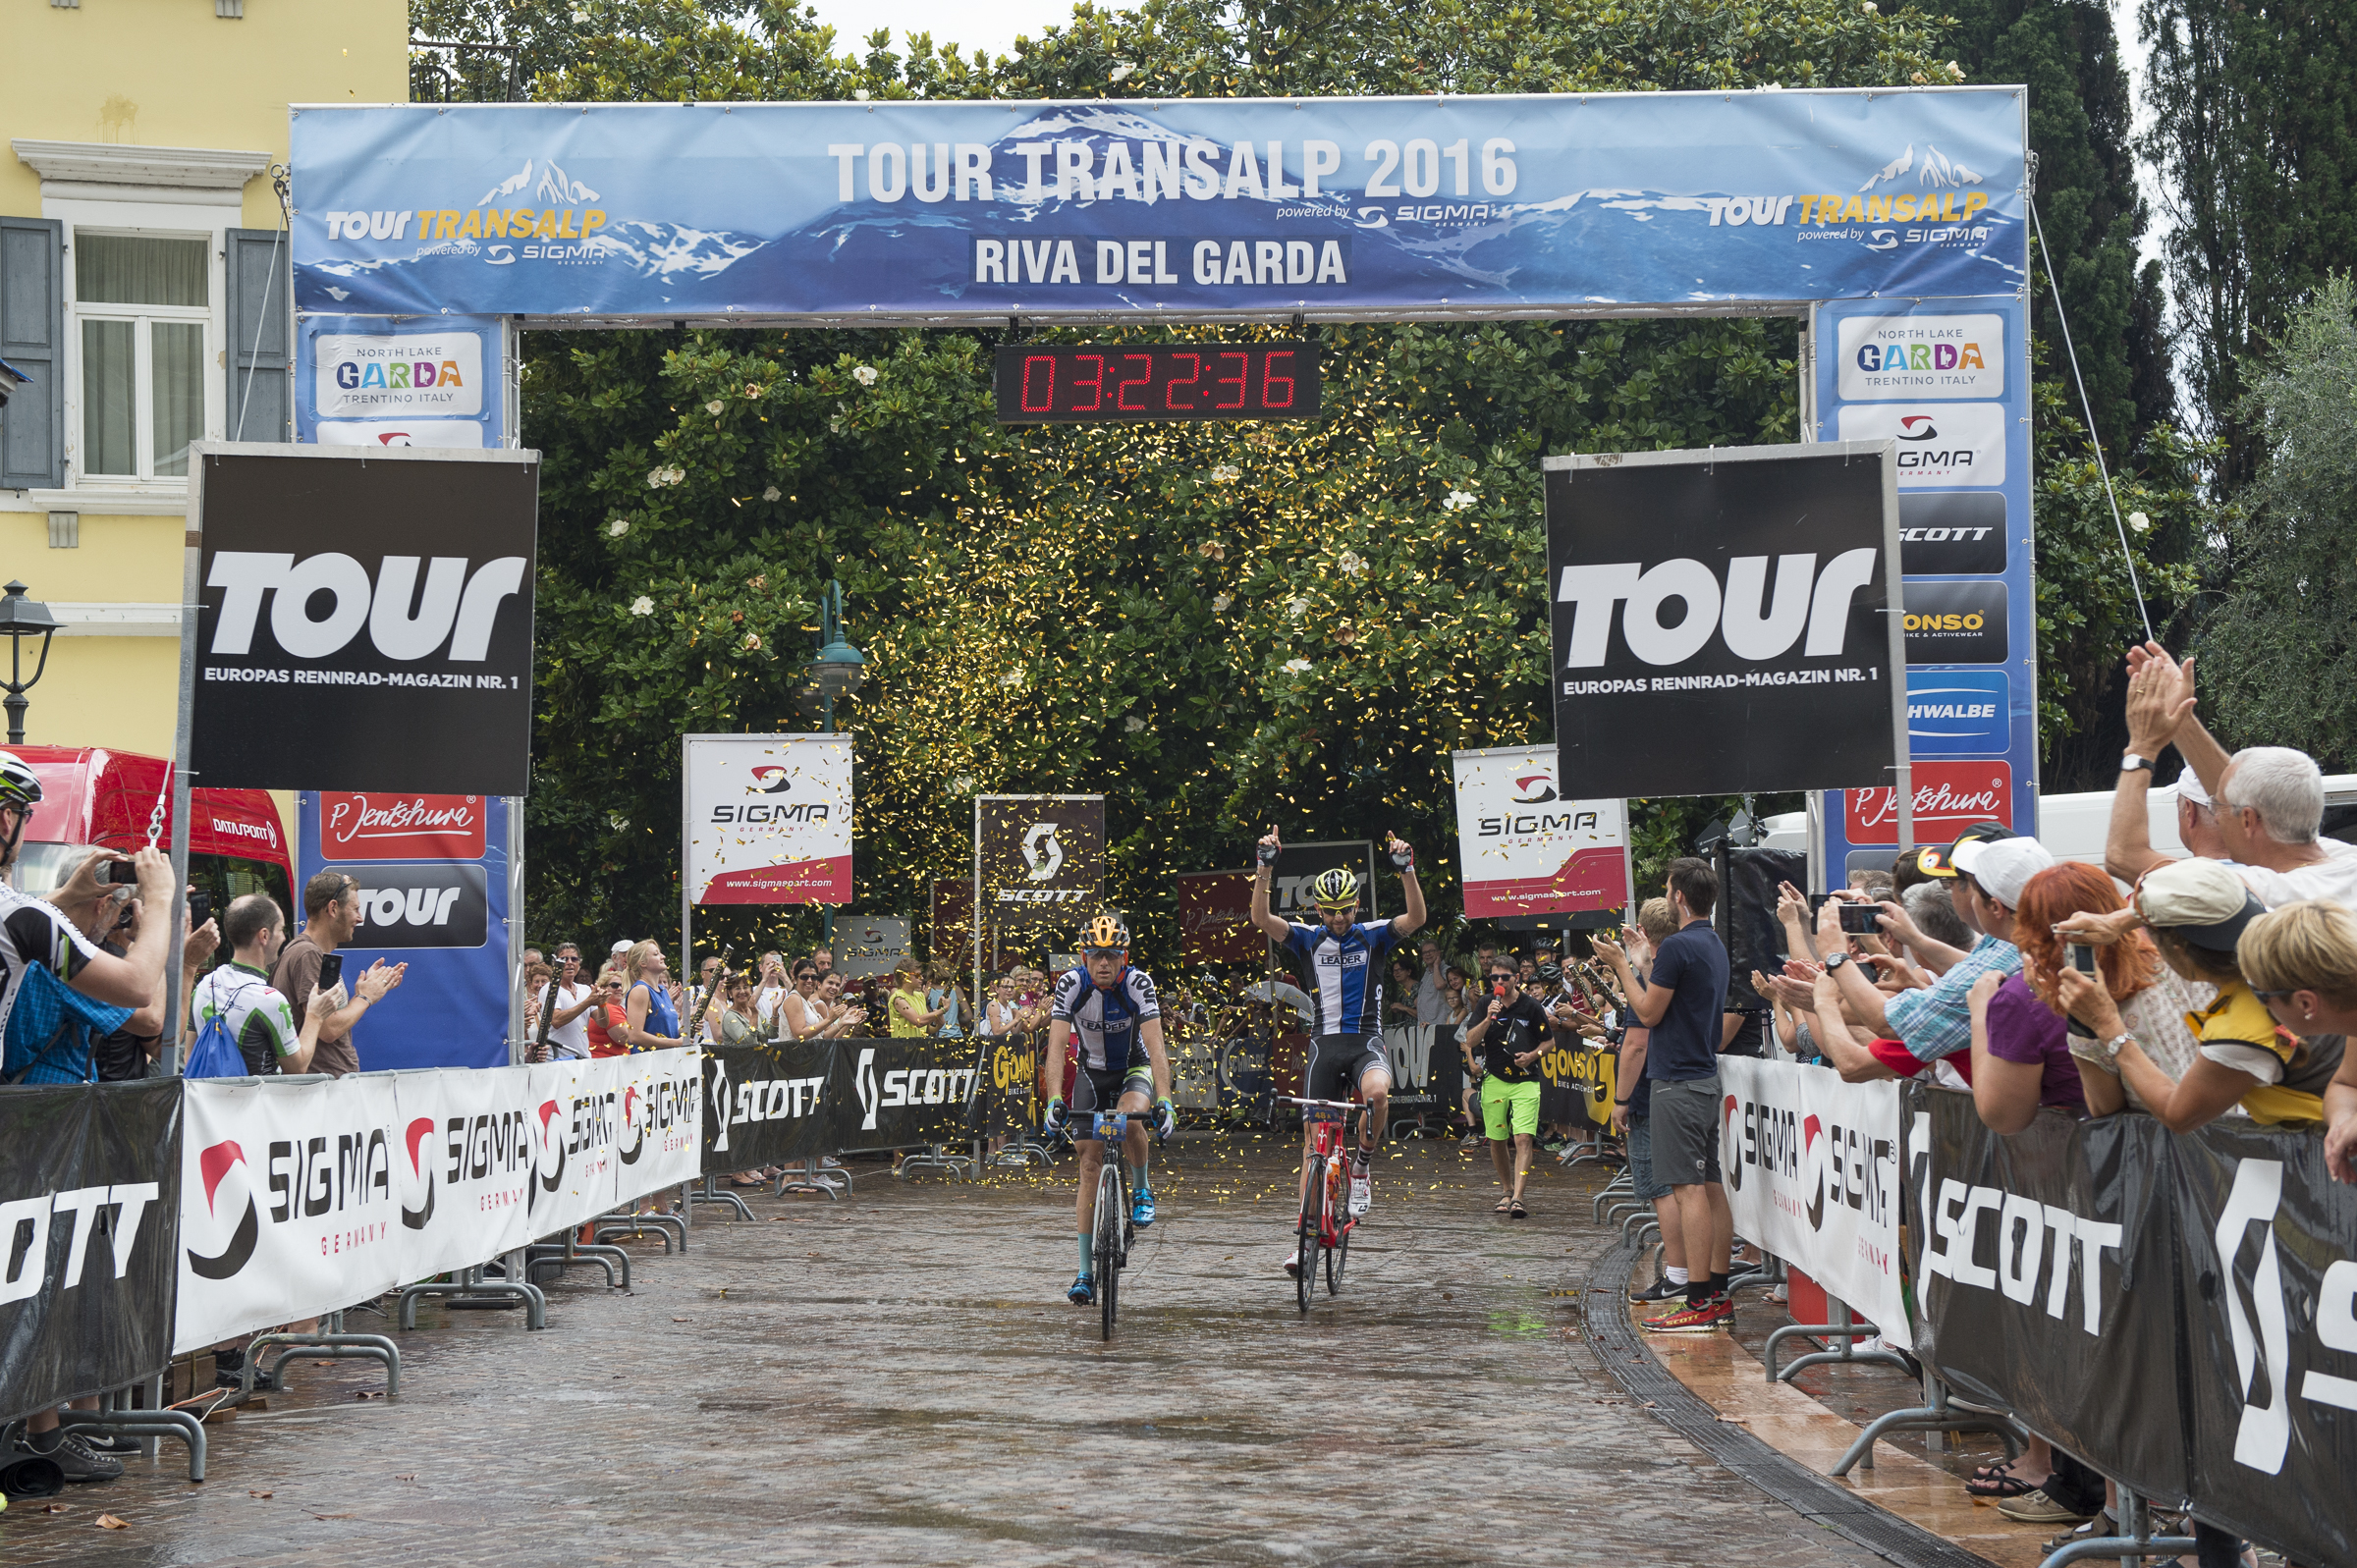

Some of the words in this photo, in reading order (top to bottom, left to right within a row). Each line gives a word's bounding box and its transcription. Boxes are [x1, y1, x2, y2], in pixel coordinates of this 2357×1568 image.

[828, 142, 994, 202] TOUR
[1016, 138, 1342, 202] TRANSALP
[1363, 136, 1518, 198] 2016
[1276, 204, 1333, 220] powered
[1334, 204, 1350, 219] by
[1395, 204, 1489, 221] SIGMA
[1798, 192, 1989, 224] TRANSALP
[416, 209, 607, 240] TRANSALP
[1797, 228, 1847, 243] powered
[1849, 227, 1865, 241] by
[1904, 227, 1988, 243] SIGMA
[416, 244, 465, 257] powered
[466, 244, 481, 257] by
[521, 245, 606, 259] SIGMA
[975, 240, 1080, 284] RIVA
[1097, 240, 1178, 284] DEL
[1192, 240, 1346, 285] GARDA
[1878, 329, 1924, 340] NORTH
[1930, 329, 1963, 339] LAKE
[356, 348, 404, 357] NORTH
[409, 347, 442, 356] LAKE
[1857, 343, 1985, 372] GARDA
[336, 360, 464, 389] GARDA
[1020, 350, 1295, 412] 03:22:36
[1865, 376, 1935, 386] TRENTINO
[1941, 375, 1976, 385] ITALY
[344, 394, 412, 404] TRENTINO
[419, 393, 454, 403] ITALY
[1897, 450, 1974, 467] GMA
[1903, 614, 1984, 630] ONSO
[204, 667, 290, 683] EUROPAS
[294, 670, 472, 689] RENNRAD-MAGAZIN
[475, 676, 507, 689] NR.
[510, 676, 519, 689] 1
[1563, 677, 1647, 695] EUROPAS
[1651, 670, 1831, 692] RENNRAD-MAGAZIN
[1835, 668, 1866, 681] NR.
[1869, 667, 1878, 680] 1
[1907, 704, 1996, 719] HWALBE
[329, 802, 350, 829] P.
[711, 804, 829, 823] SIGMA
[212, 818, 268, 840] DATASPORT
[1478, 812, 1597, 837] SIGMA
[1507, 835, 1573, 844] GERMANY
[726, 879, 833, 890] www.sigmasport.com
[996, 889, 1089, 901] SCOTT
[1491, 889, 1602, 901] www.sigmasport.com
[848, 947, 901, 957] SIGMA
[1321, 953, 1361, 965] LEADER
[1081, 1021, 1126, 1031] LEADER
[880, 1068, 976, 1107] SCOTT
[732, 1075, 826, 1124] SCOTT
[447, 1110, 528, 1185] SIGMA
[1744, 1101, 1798, 1182] SIGMA
[268, 1128, 389, 1223] SIGMA
[1830, 1124, 1890, 1228] SIGMA
[0, 1181, 159, 1307] OTT
[321, 1220, 386, 1257] GERMANY
[1930, 1177, 2123, 1337] SCOTT
[1666, 1313, 1700, 1325] SCOTT
